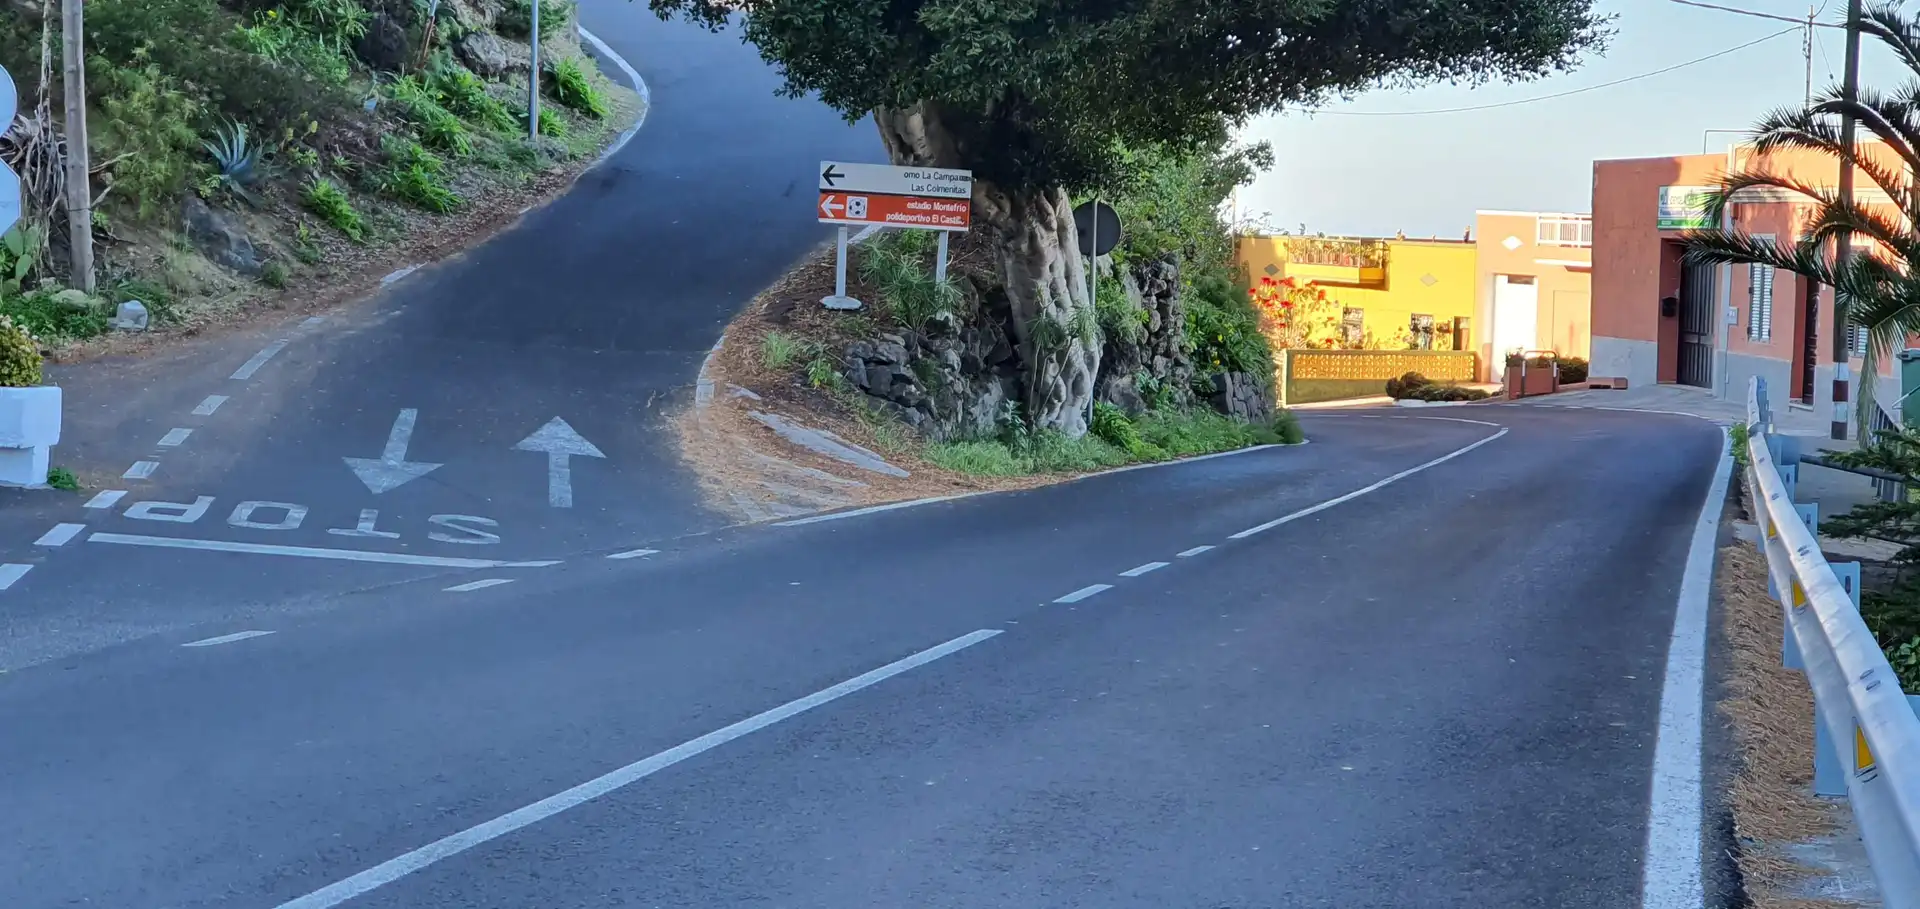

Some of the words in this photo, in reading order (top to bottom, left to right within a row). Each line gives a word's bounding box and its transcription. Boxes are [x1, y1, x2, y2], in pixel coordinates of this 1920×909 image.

[922, 171, 931, 179] La
[911, 184, 925, 192] Las
[927, 184, 967, 194] Colmenitas
[906, 201, 931, 210] estadio
[886, 212, 931, 224] polideportivo
[932, 214, 939, 222] El
[122, 495, 501, 545] STOP
